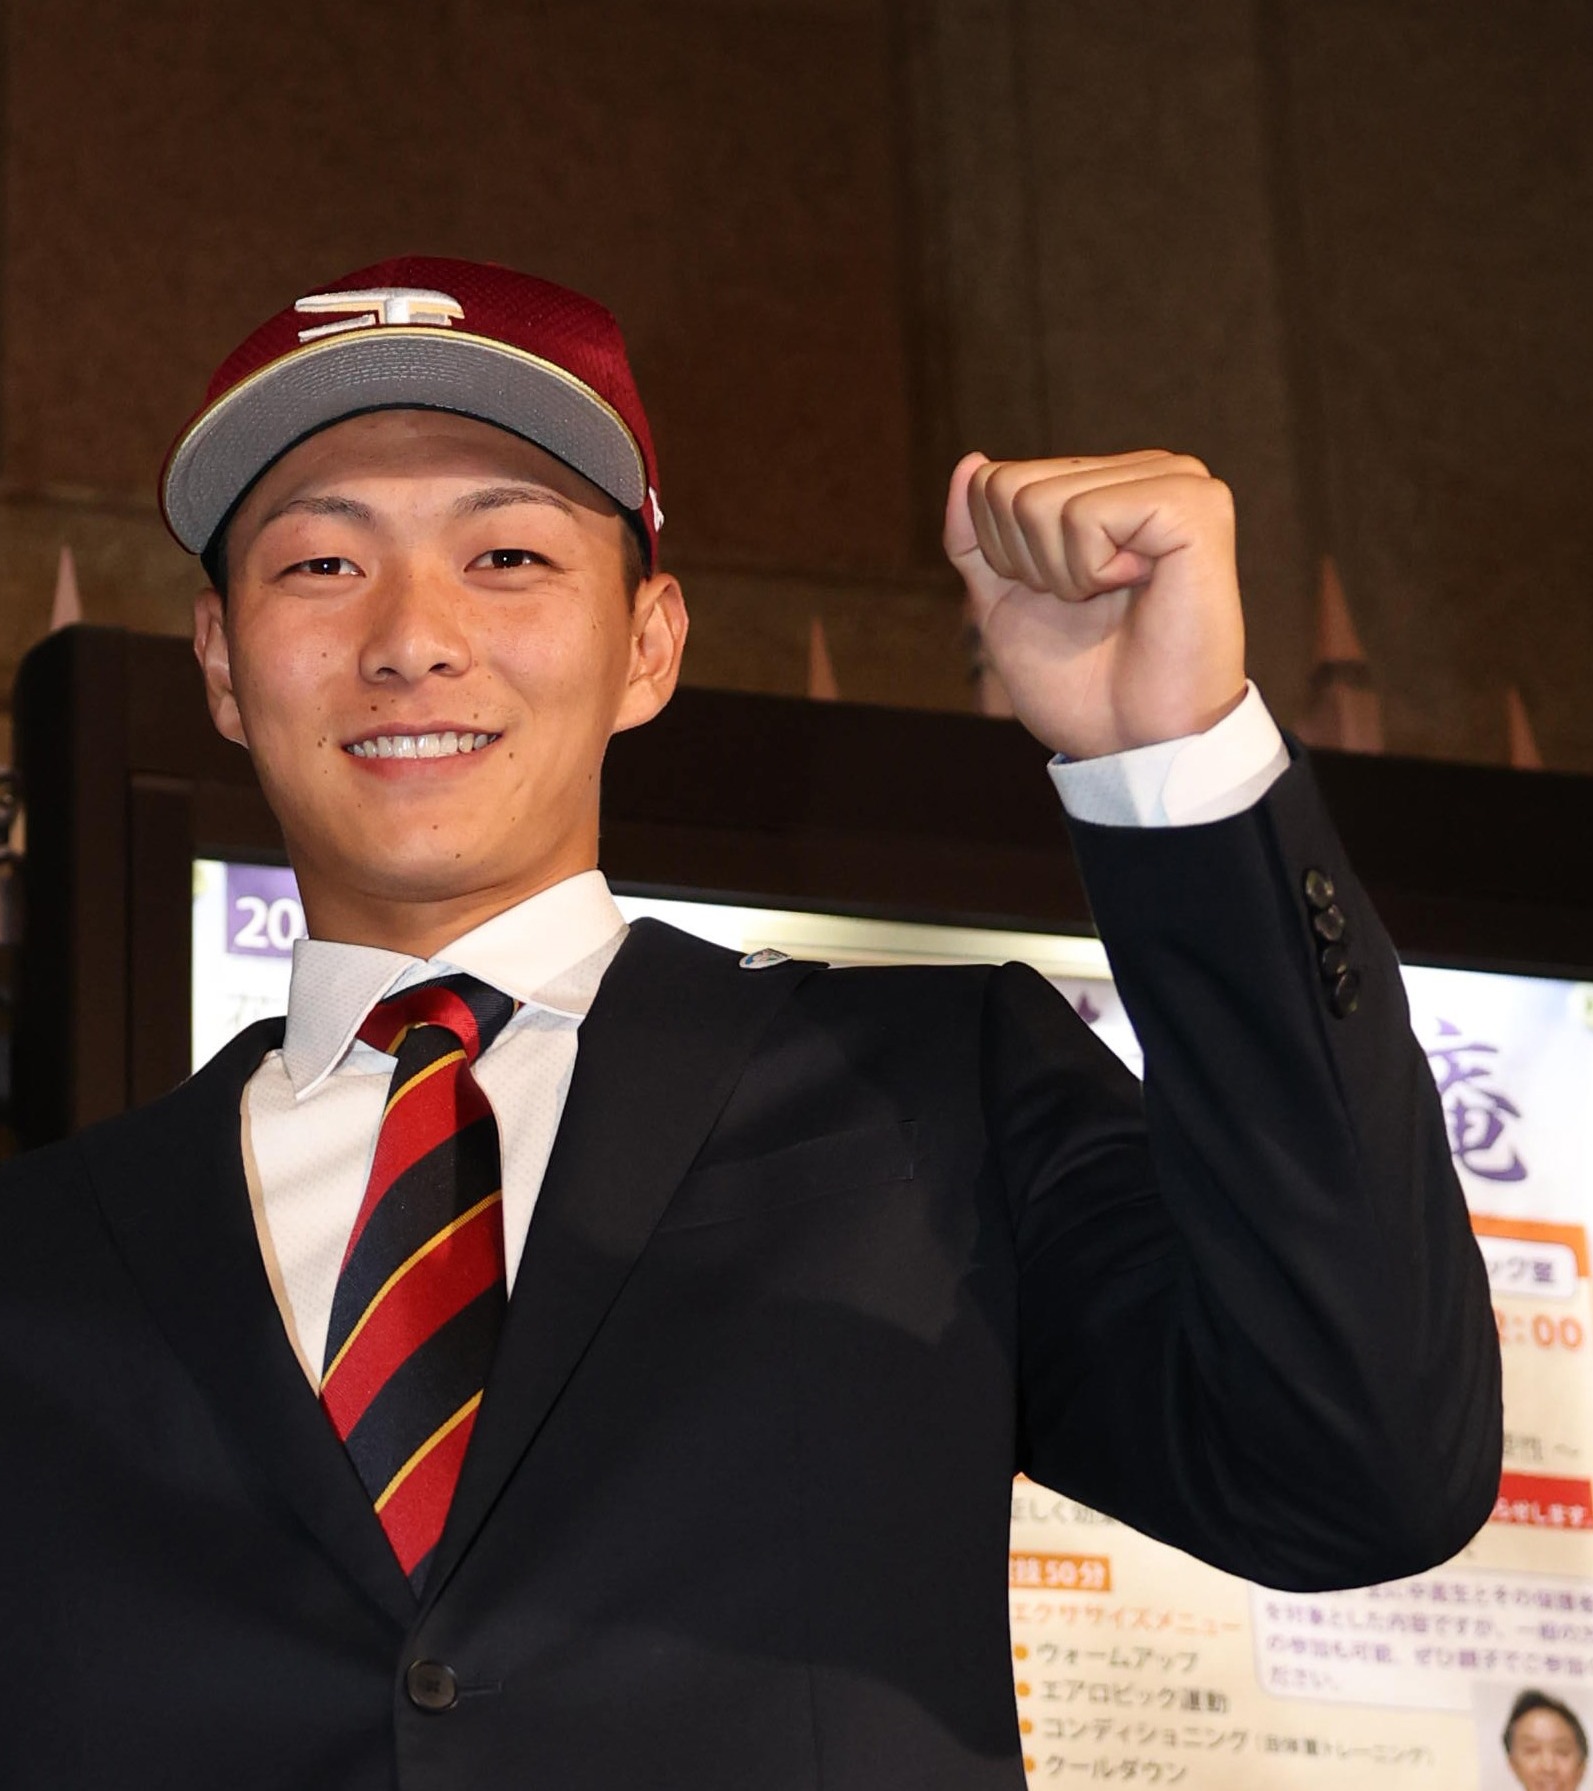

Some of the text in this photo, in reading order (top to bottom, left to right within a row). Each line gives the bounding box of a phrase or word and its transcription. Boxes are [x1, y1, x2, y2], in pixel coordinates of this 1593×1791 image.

[1037, 1643, 1199, 1672] ウォームアップ
[1041, 1680, 1231, 1713] エアロビック運動
[1045, 1755, 1188, 1784] クールダウン
